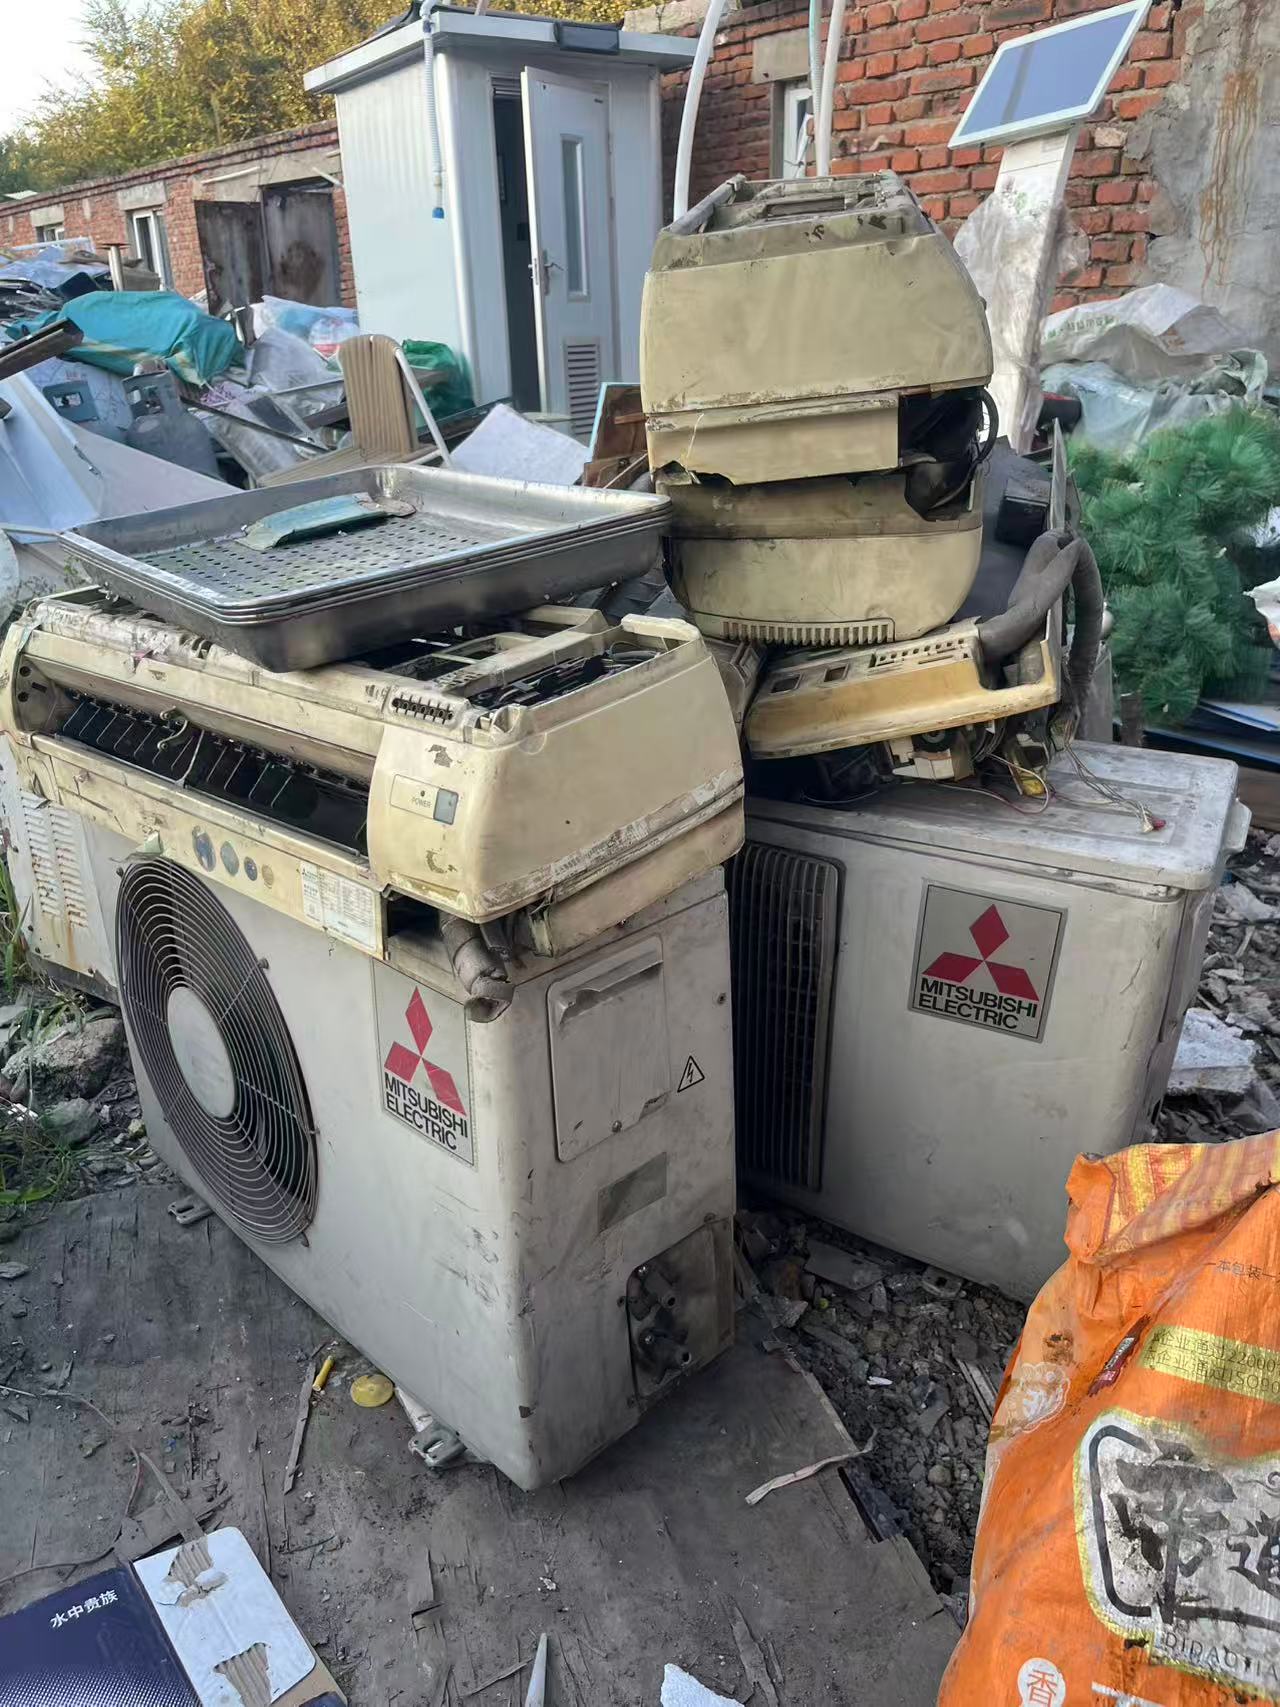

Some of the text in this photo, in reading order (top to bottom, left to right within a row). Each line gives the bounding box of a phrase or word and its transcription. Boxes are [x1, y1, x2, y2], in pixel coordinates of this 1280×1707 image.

[918, 993, 1019, 1029] ELECTRIC
[920, 977, 1038, 1018] MITSUBISHI
[384, 1071, 468, 1138] MITSUBISHI
[386, 1091, 457, 1151] ELECTRIC
[50, 1589, 119, 1628] 水中贵族
[1026, 1668, 1058, 1707] 香
